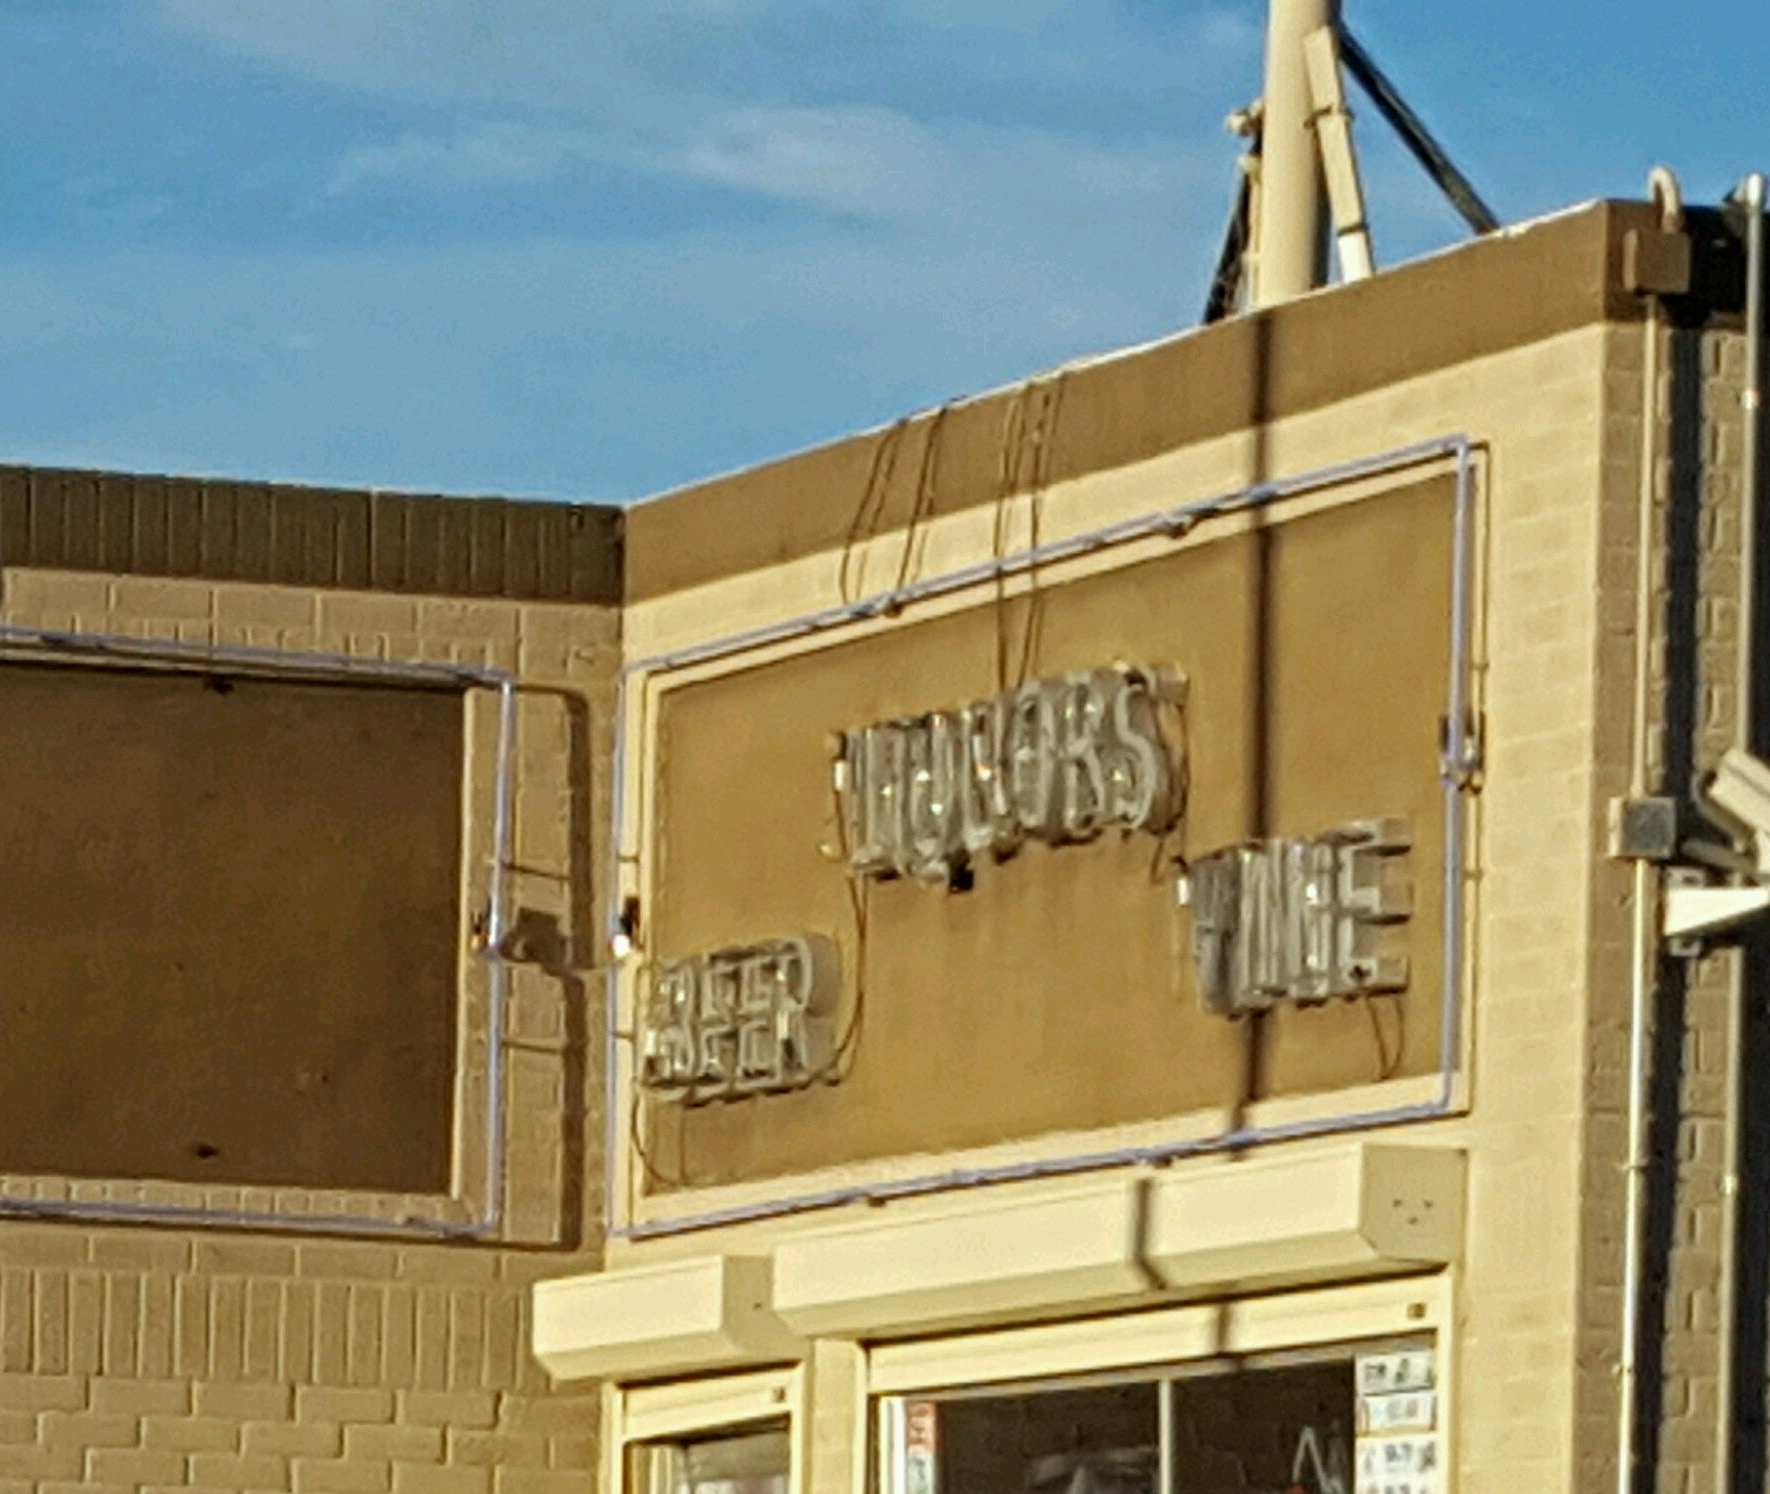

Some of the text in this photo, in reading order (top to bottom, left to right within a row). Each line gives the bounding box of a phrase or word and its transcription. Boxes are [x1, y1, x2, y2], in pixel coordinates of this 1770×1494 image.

[837, 664, 1181, 878] LIQUORS
[1187, 818, 1411, 1016] WINE
[641, 932, 841, 1106] BEER
